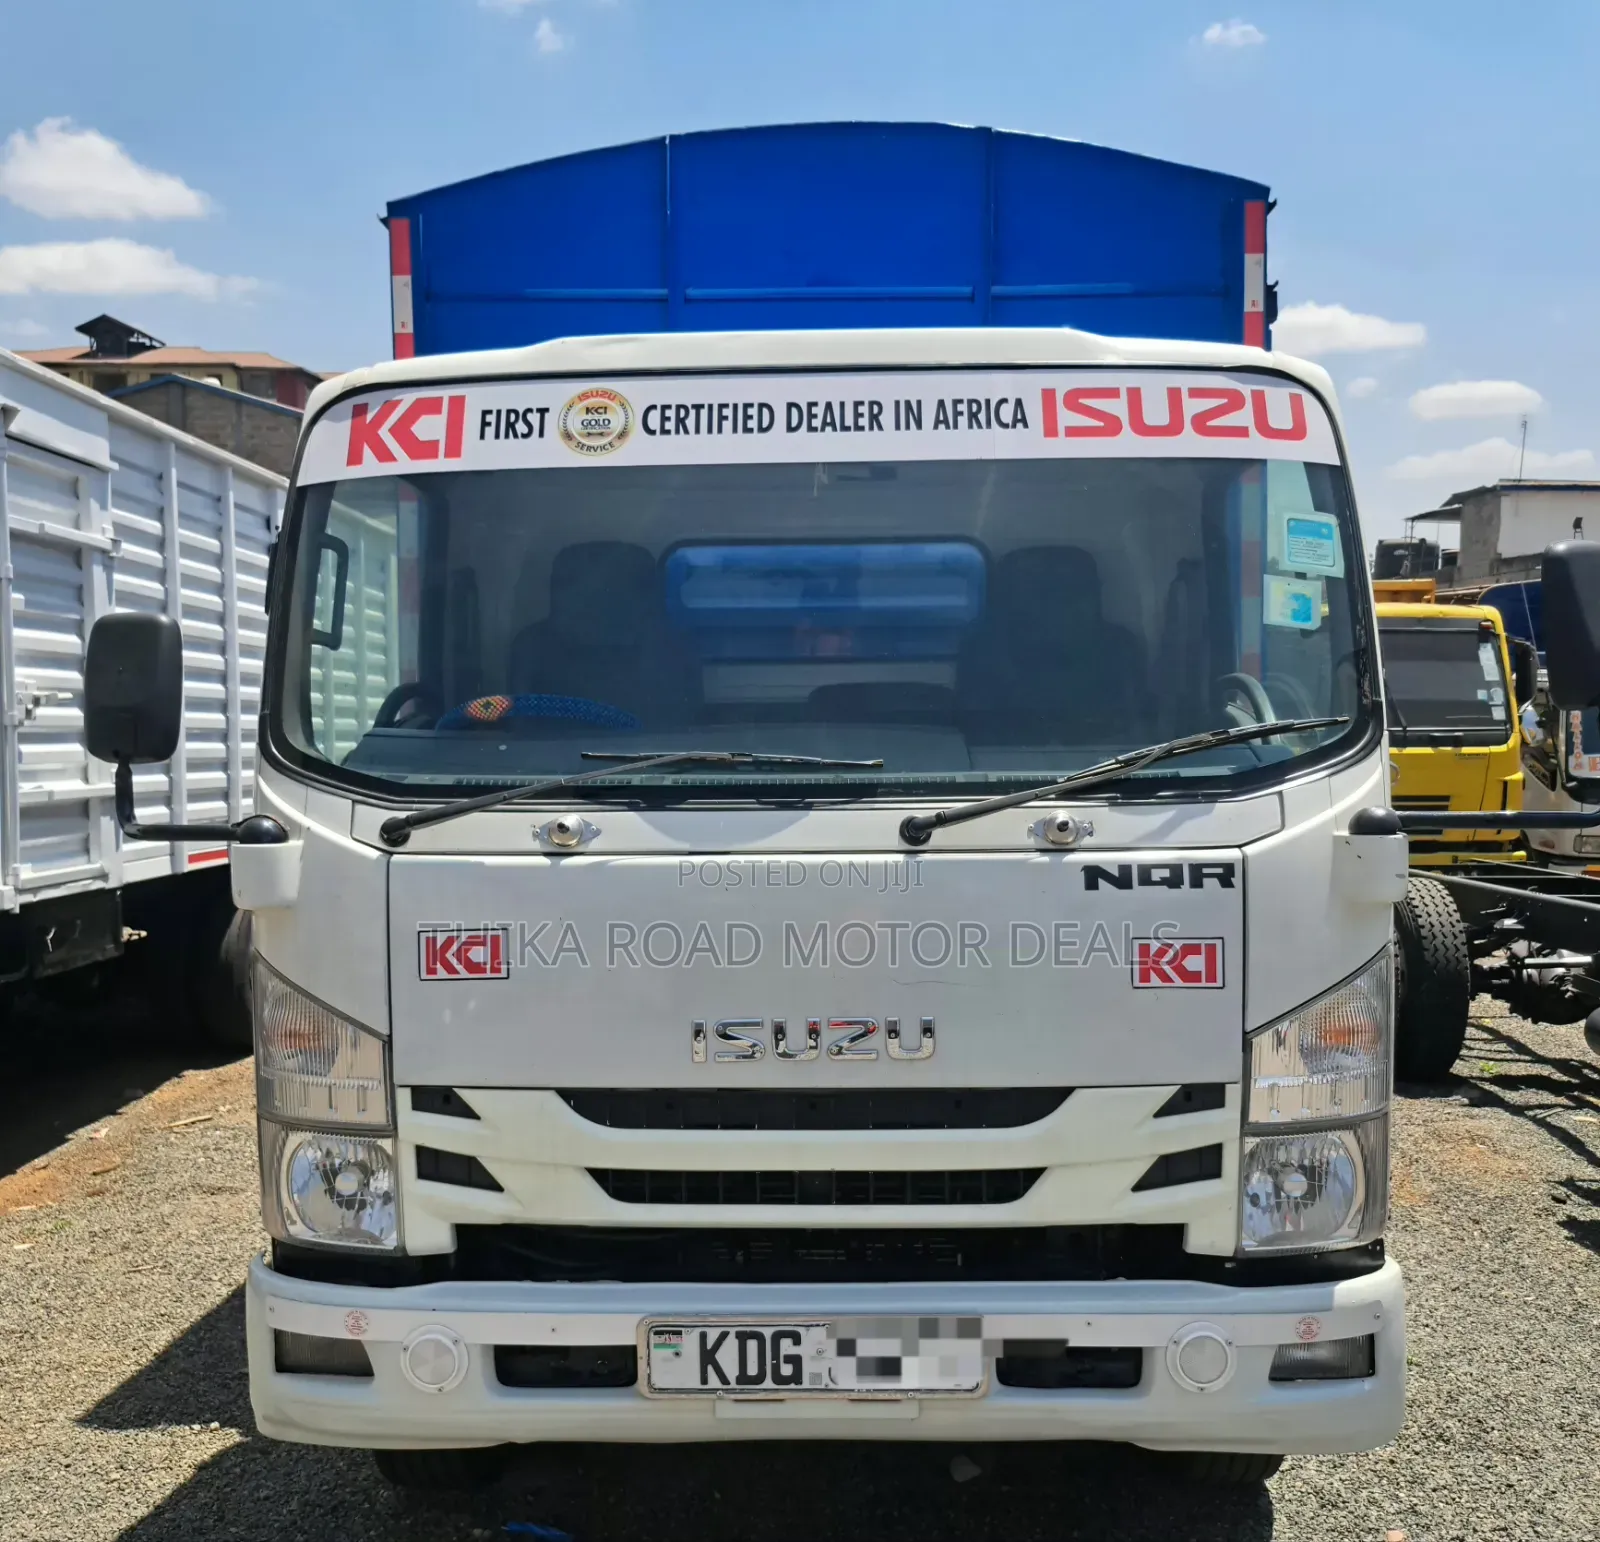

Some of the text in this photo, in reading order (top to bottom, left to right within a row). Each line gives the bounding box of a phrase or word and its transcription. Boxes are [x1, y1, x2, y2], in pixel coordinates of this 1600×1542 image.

[577, 390, 617, 401] ISUZU
[585, 406, 608, 415] KCI
[346, 386, 1307, 467] KCI FIRST CERTIFIED DEALER IN AFRICA ISUZU
[581, 418, 611, 427] GOLD
[575, 441, 615, 452] SERVICE
[1081, 863, 1236, 891] NQR
[425, 934, 503, 976] KCI
[1138, 942, 1218, 984] KCI
[691, 1017, 936, 1064] ISUZU
[699, 1330, 803, 1386] KDG
